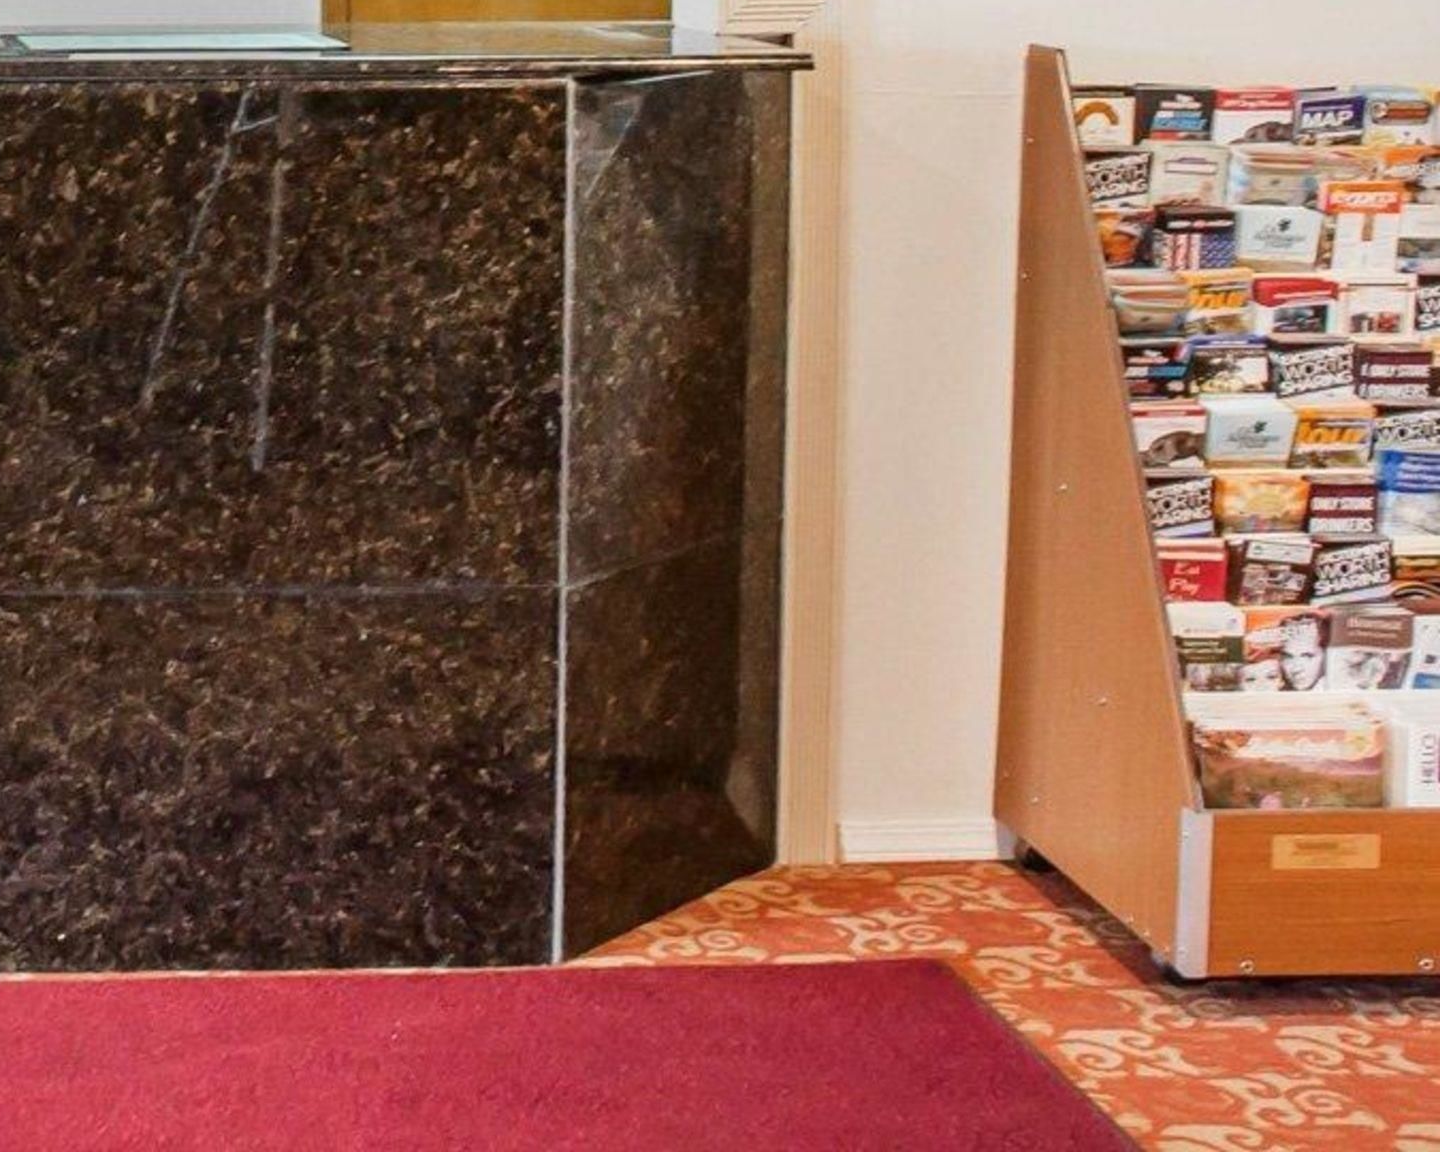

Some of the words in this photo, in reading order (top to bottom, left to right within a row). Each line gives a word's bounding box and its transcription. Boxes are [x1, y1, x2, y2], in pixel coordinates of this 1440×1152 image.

[1301, 110, 1354, 128] MAP
[1284, 351, 1353, 380] WORTH
[1315, 552, 1391, 580] WORTH
[1314, 570, 1392, 597] SHARING
